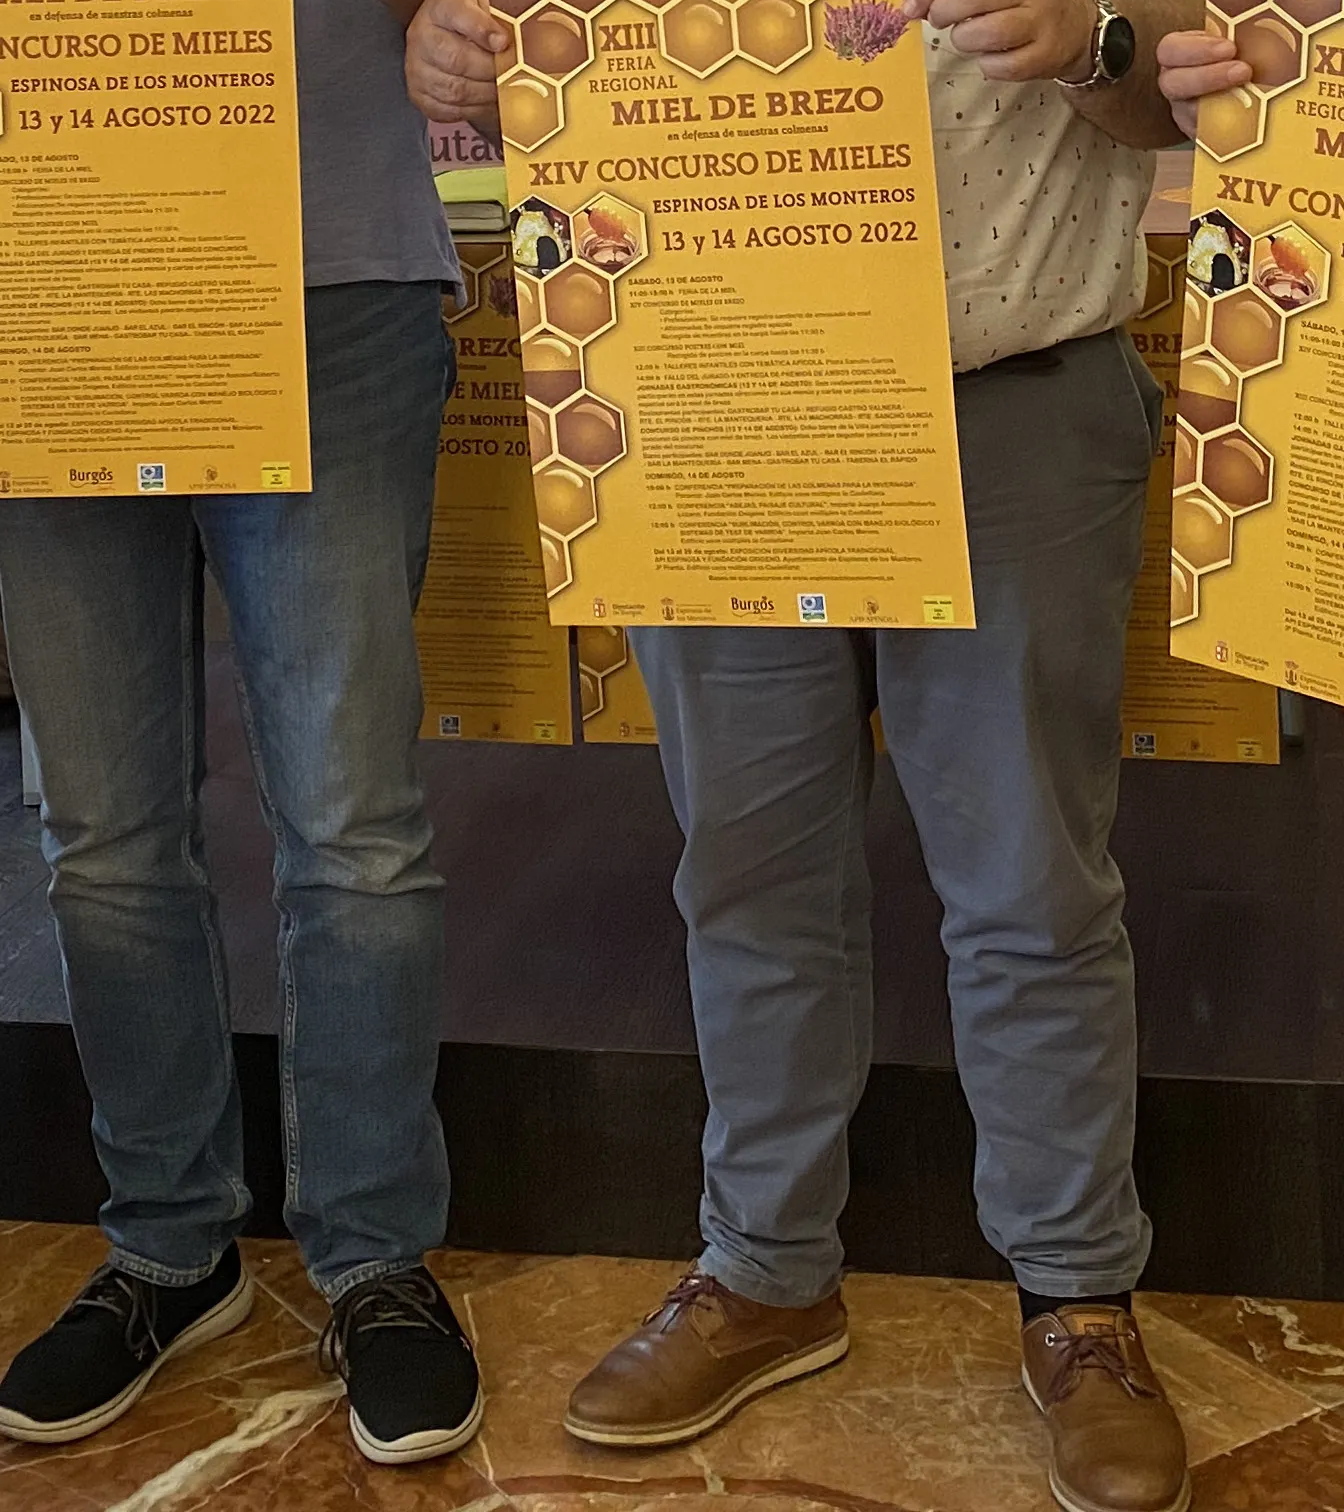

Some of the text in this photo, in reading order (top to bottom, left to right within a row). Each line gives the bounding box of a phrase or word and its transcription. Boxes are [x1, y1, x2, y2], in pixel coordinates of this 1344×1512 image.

[128, 32, 165, 56] DE
[172, 30, 272, 55] MIELES
[600, 22, 657, 52] XIII
[606, 56, 656, 72] FERIA
[11, 72, 275, 93] ESPINOSA DE LOS MONTEROS
[589, 75, 678, 93] REGIONAL
[19, 104, 275, 134] 13 y 14 AGOSTO 2022
[611, 86, 884, 126] MIEL DE BREZO
[528, 143, 911, 186] XIV CONCURSO DE MIELES
[653, 188, 915, 214] ESPINOSA DE LOS MONTEROS
[1217, 174, 1282, 207] XIV
[662, 221, 918, 255] 13 y 14 AGOSTO 2022
[69, 467, 113, 484] Burgos
[731, 596, 774, 614] Burgos
